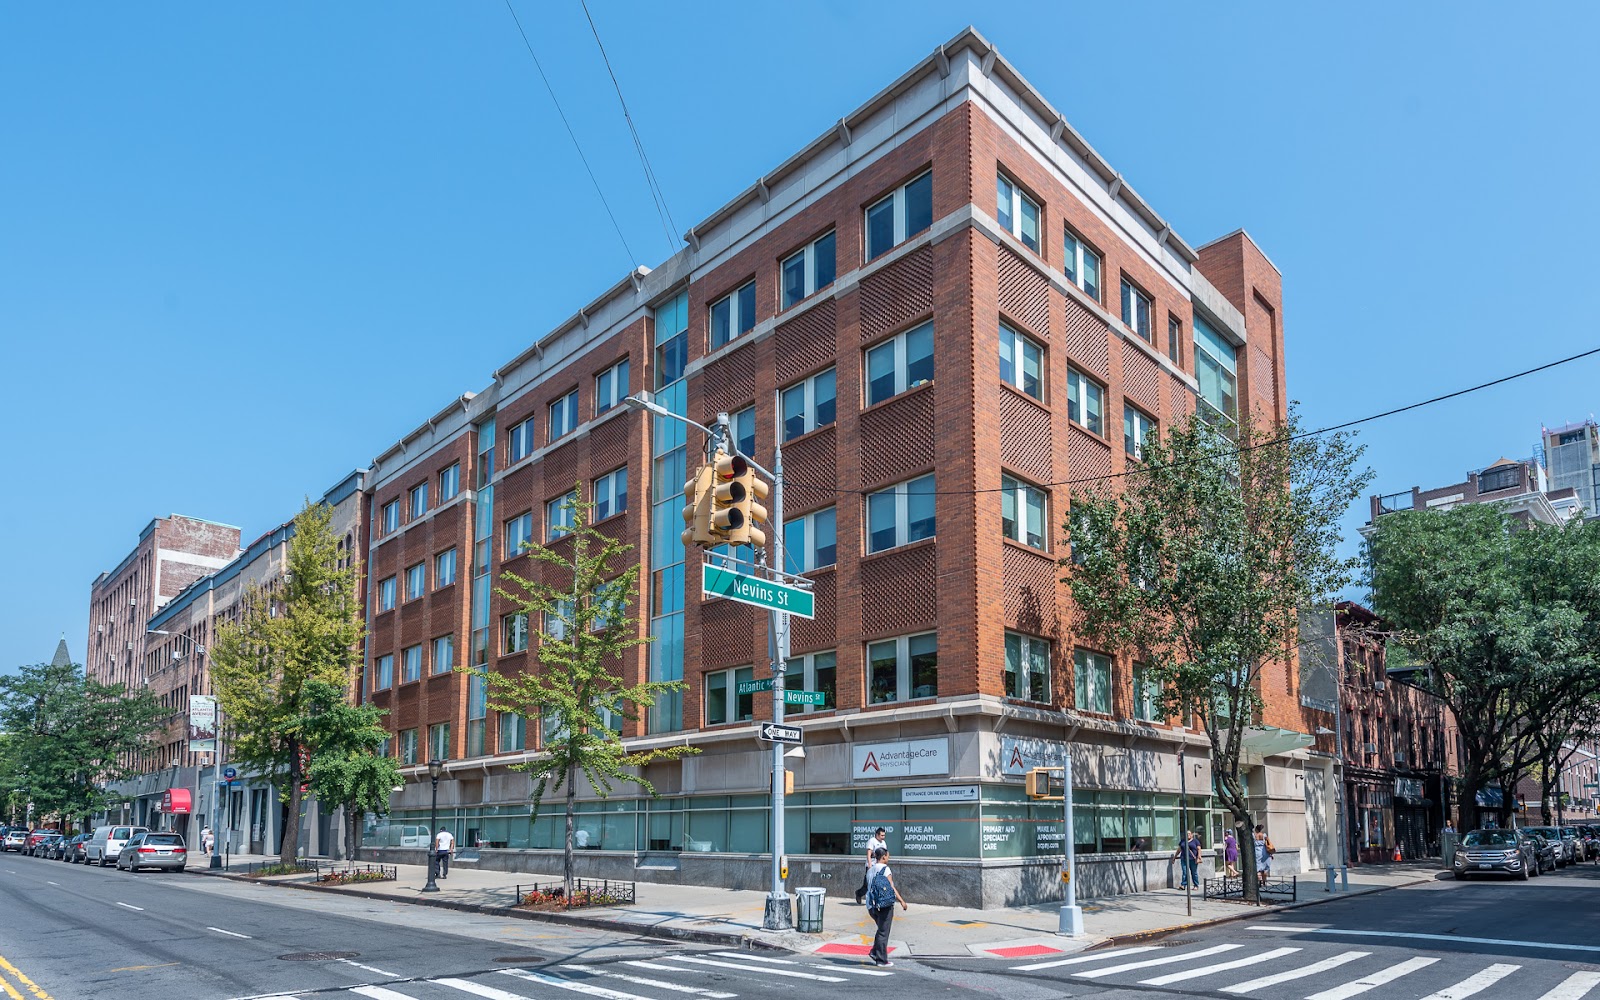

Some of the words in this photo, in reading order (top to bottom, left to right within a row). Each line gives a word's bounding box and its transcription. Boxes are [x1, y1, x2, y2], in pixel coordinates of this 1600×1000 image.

[733, 578, 774, 602] Nevins
[777, 590, 789, 606] St
[738, 680, 765, 694] Atlantic
[787, 691, 814, 703] Nevins
[767, 728, 780, 737] ONE
[784, 730, 798, 738] WAY
[880, 748, 938, 760] AdvantageCare
[880, 760, 911, 768] PHYSICIANS
[983, 825, 1004, 833] PRIMARY
[1005, 825, 1016, 833] AND
[1036, 825, 1049, 833] MAKE
[1050, 825, 1057, 833] AN
[904, 834, 951, 842] APPOINTMENT
[983, 834, 1009, 842] SPECIALTY
[904, 842, 937, 851] acpny.com
